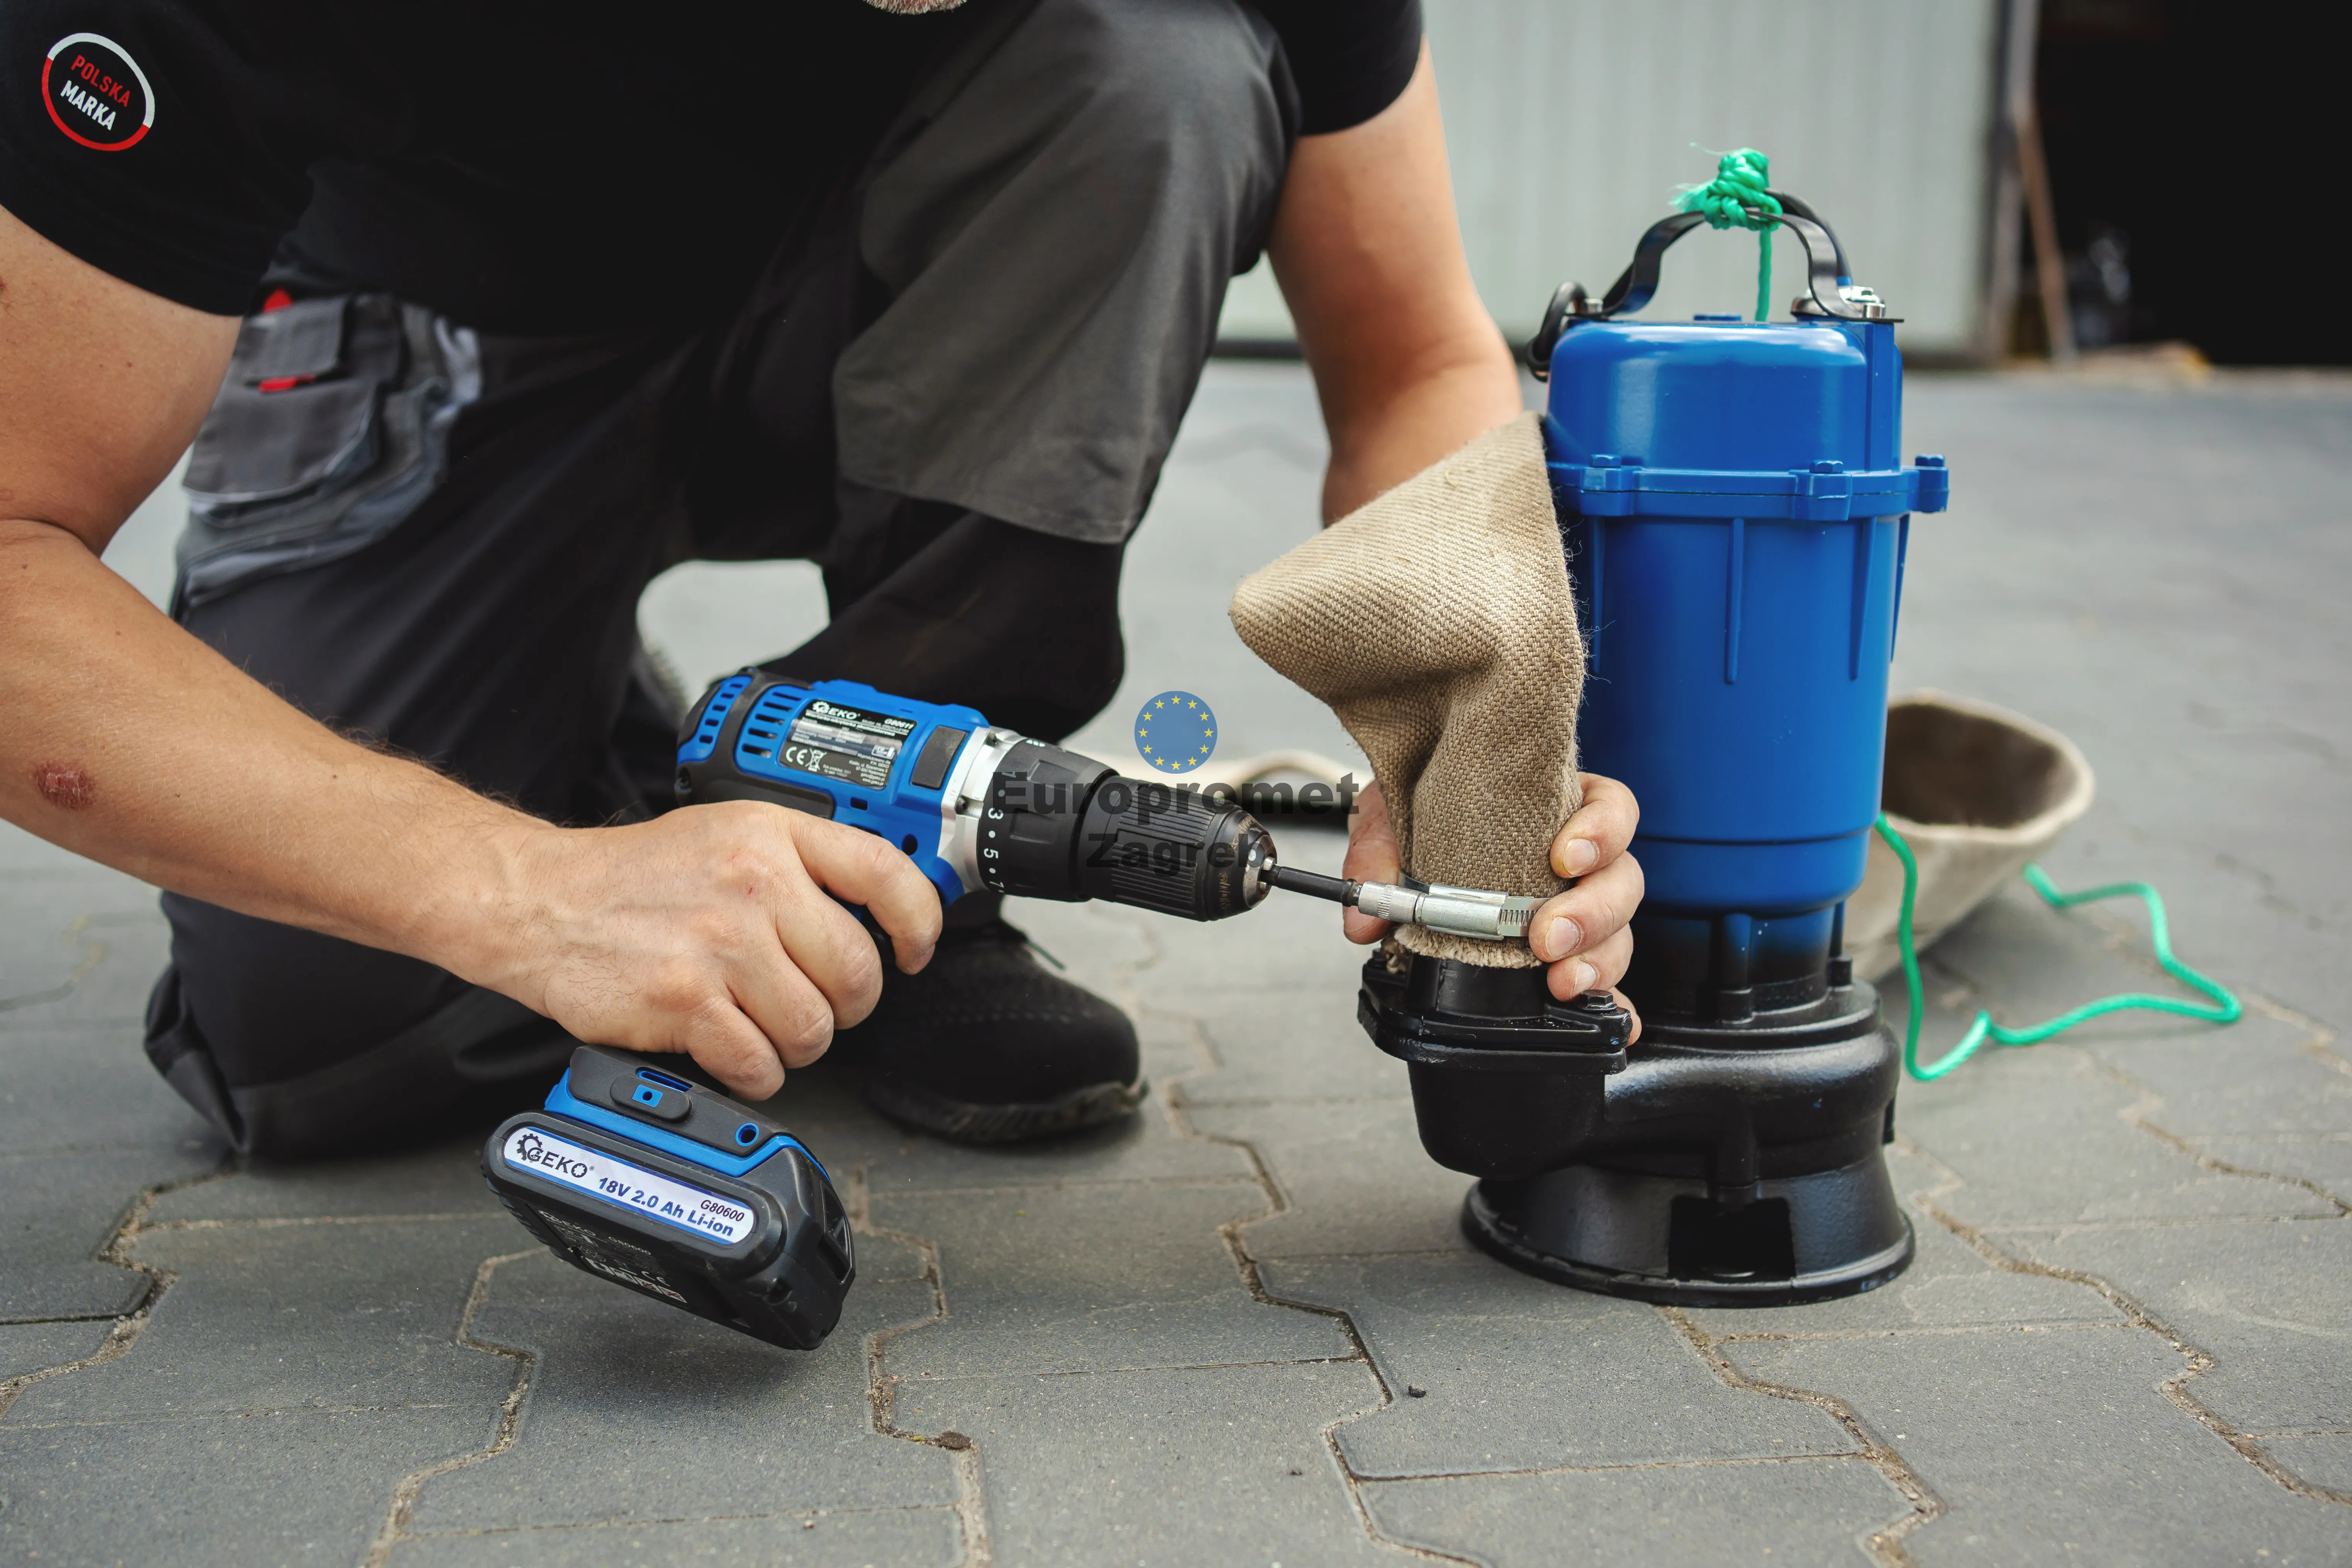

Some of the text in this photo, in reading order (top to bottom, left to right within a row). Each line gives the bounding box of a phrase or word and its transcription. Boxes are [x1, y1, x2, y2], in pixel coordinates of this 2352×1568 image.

[71, 54, 131, 107] POLSKA
[60, 80, 117, 131] MARKA
[988, 807, 1004, 820] 3
[984, 848, 999, 859] 5
[527, 1146, 588, 1178] GEKO
[599, 1177, 734, 1237] 18V 2.0 Ah Li-ion
[700, 1199, 745, 1222] G80600
